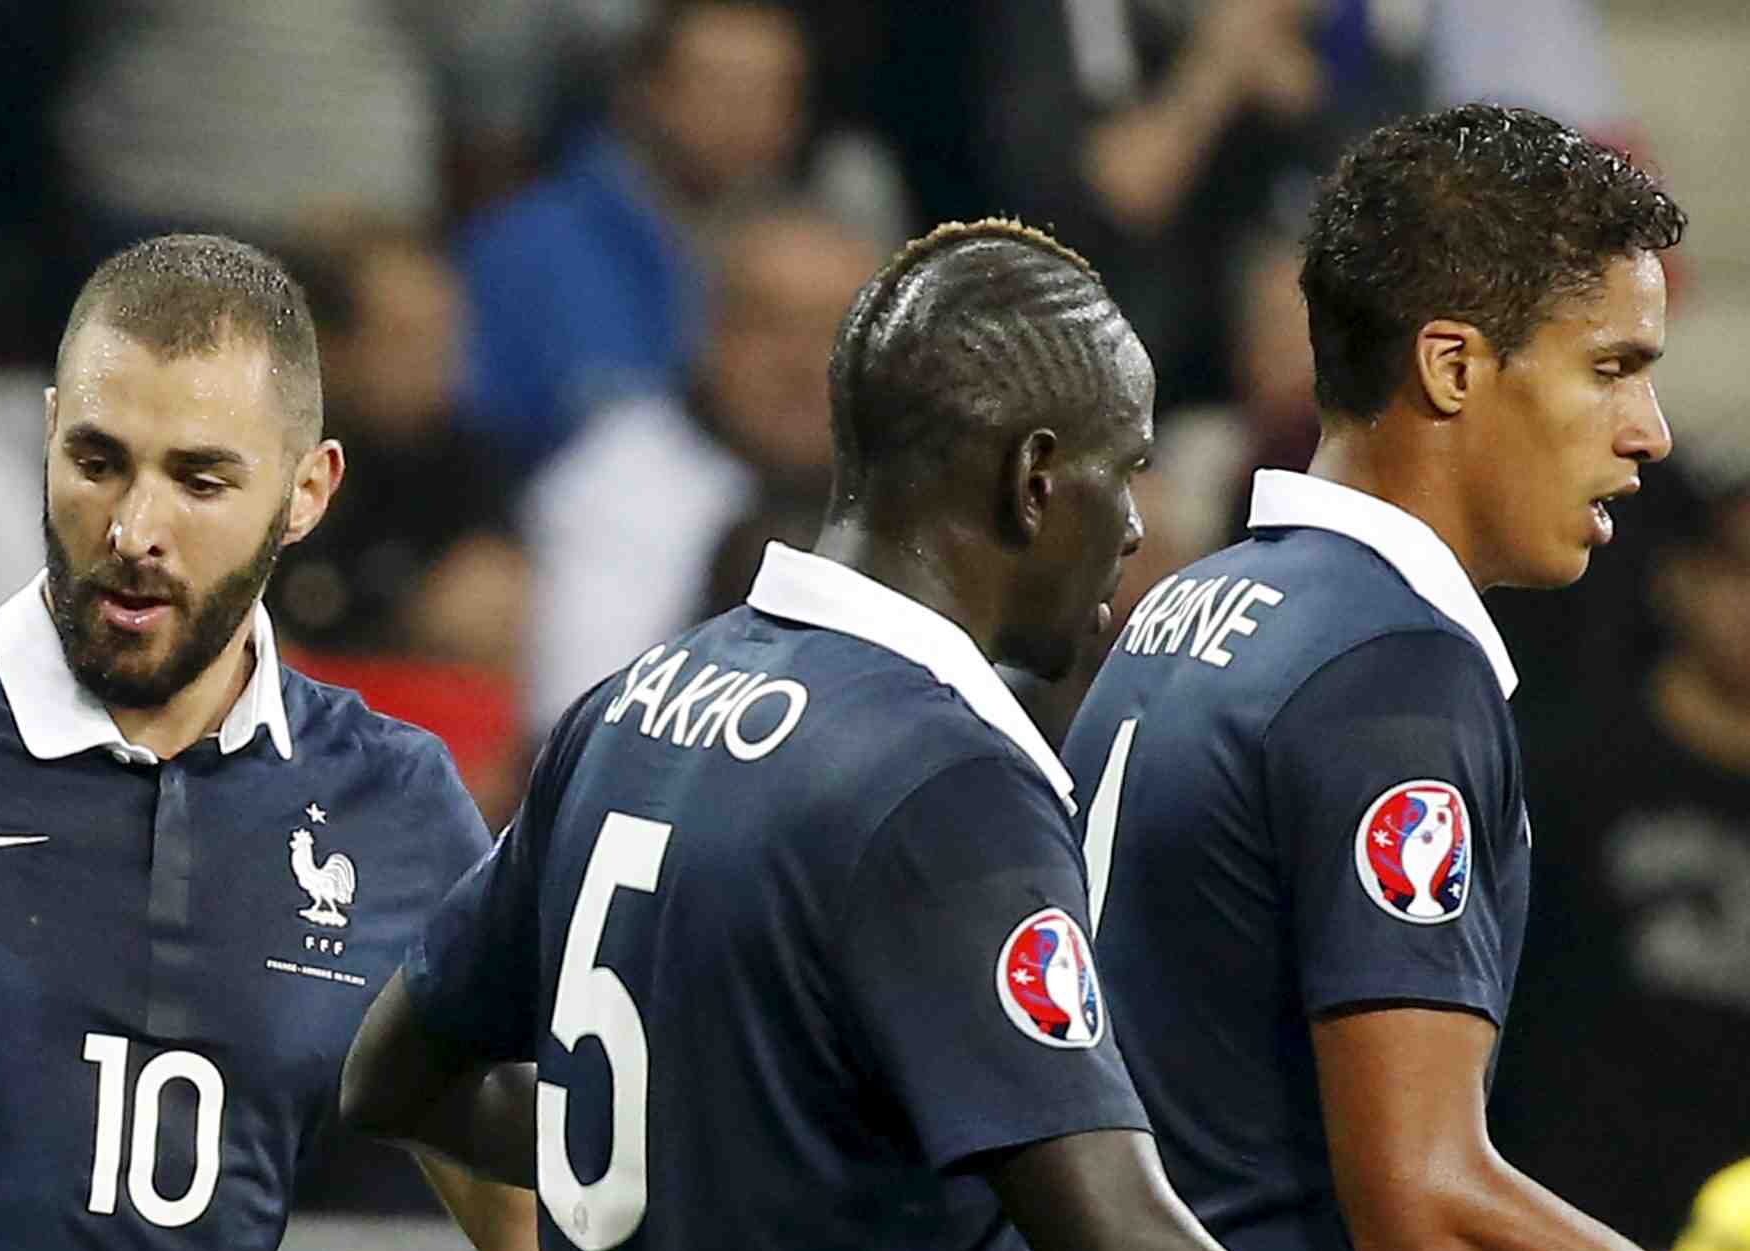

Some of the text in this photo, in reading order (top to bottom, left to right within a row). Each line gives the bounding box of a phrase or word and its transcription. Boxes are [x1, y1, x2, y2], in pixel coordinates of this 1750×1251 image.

[1116, 574, 1285, 667] ARANE
[603, 642, 809, 762] SAKHO
[83, 1032, 225, 1228] 10
